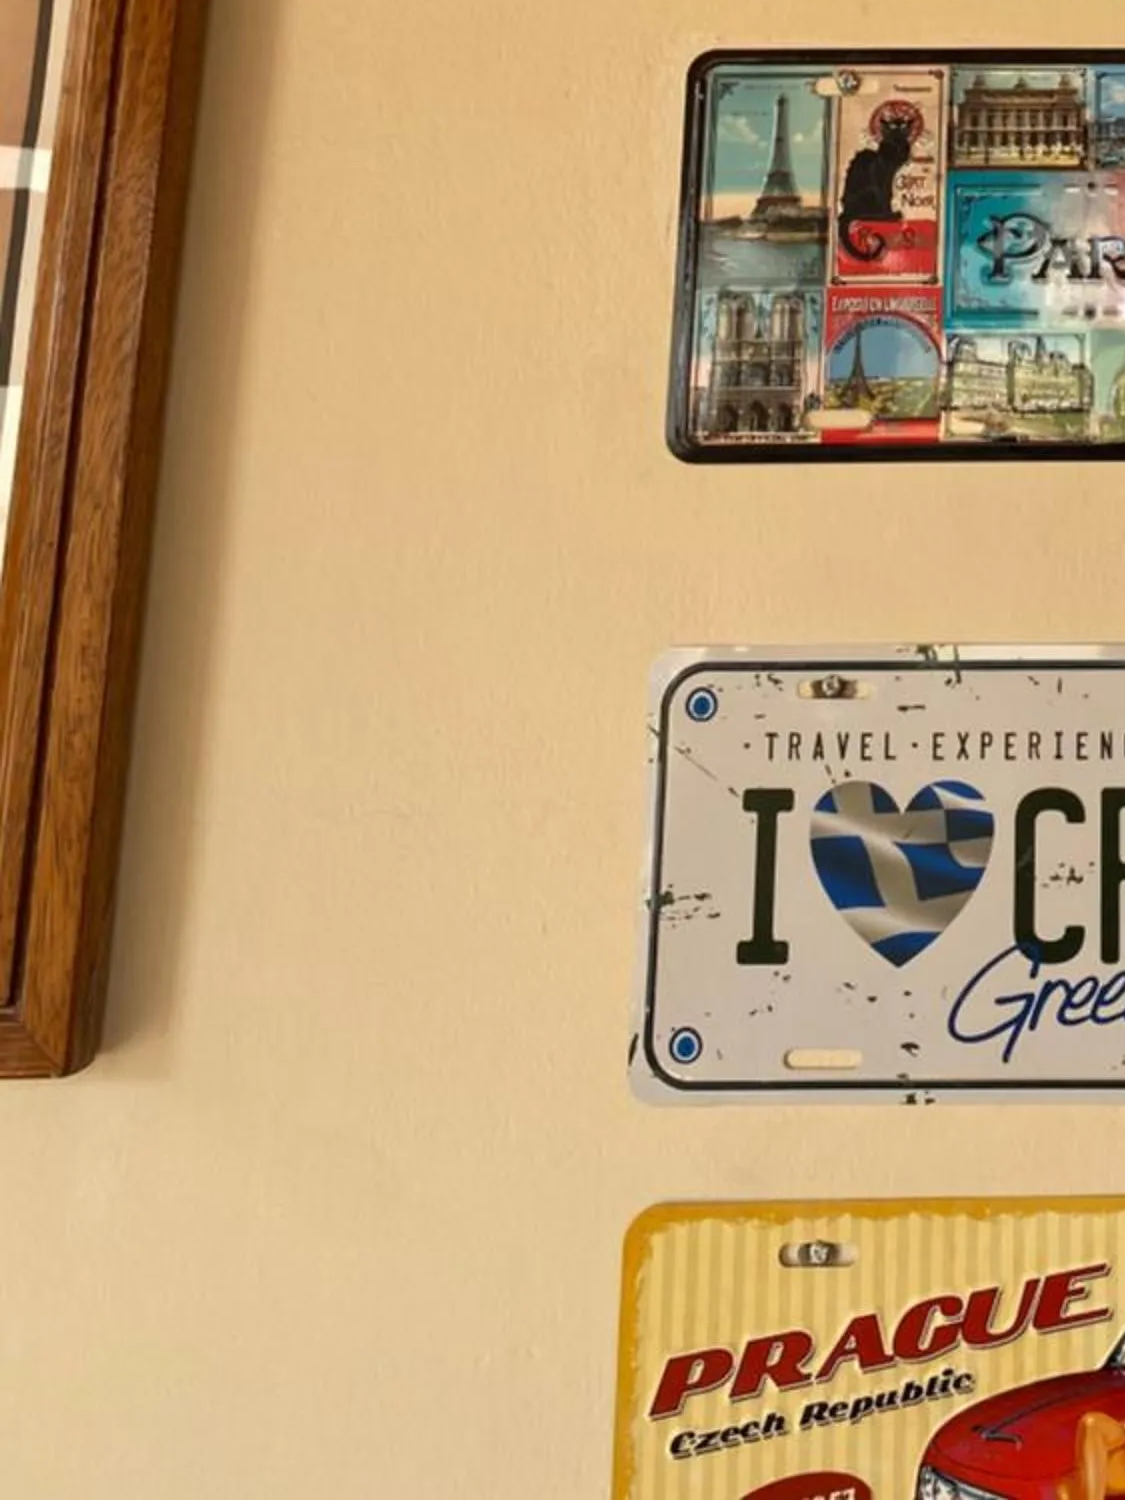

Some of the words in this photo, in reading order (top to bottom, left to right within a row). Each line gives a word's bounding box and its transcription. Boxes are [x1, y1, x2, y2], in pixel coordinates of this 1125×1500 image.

[764, 731, 898, 762] TRAVEL
[736, 787, 796, 965] I
[648, 1262, 1113, 1422] PRAGUE
[669, 1414, 786, 1458] Czech
[799, 1368, 976, 1430] Republic
